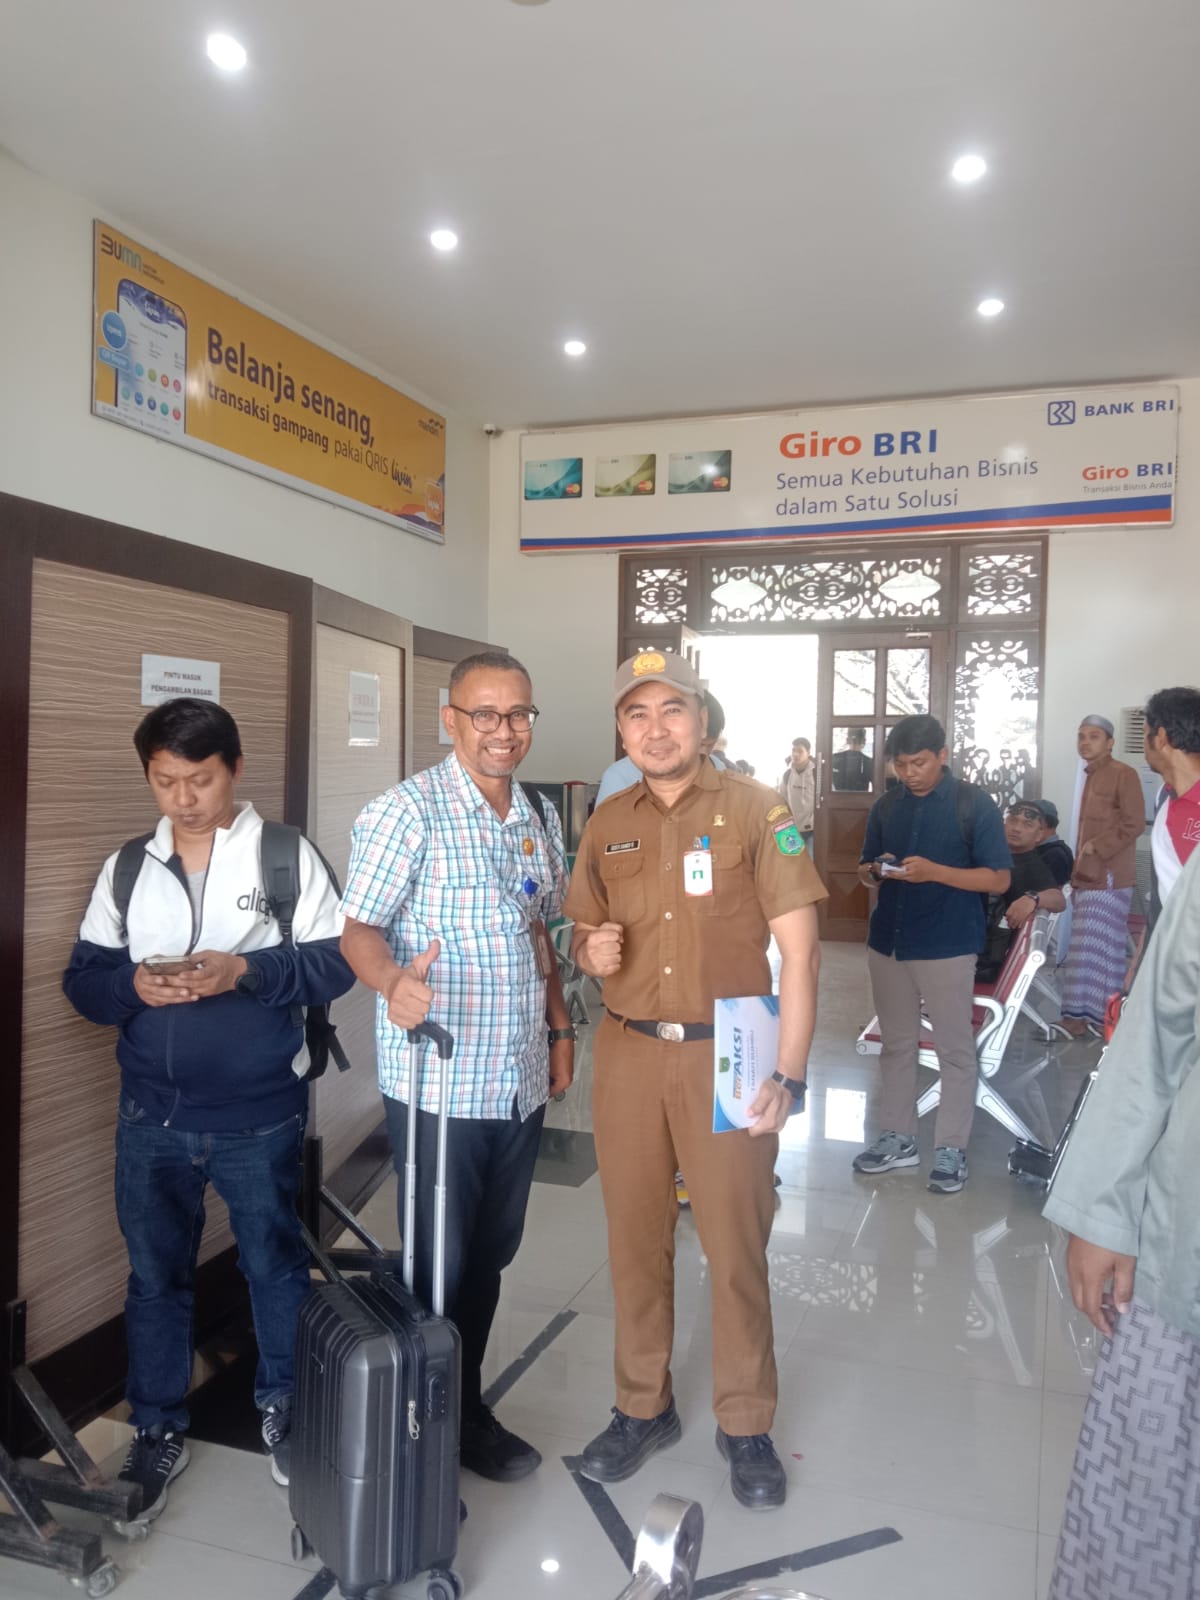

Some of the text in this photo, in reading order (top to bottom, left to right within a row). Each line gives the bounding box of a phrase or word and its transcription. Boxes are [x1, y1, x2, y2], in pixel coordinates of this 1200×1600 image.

[208, 327, 375, 448] Belanja senang,
[1085, 399, 1174, 416] BANK BRI
[208, 381, 270, 424] transaksi
[273, 413, 329, 453] gampang
[335, 440, 363, 465] pakai
[366, 449, 389, 476] QRIS
[779, 429, 938, 459] Giro BRI
[776, 456, 1039, 490] Semua Kebutuhan Bisnis
[1082, 462, 1173, 480] Giro BRI
[1149, 480, 1173, 489] Anda
[776, 488, 958, 516] dalam Satu Solusi
